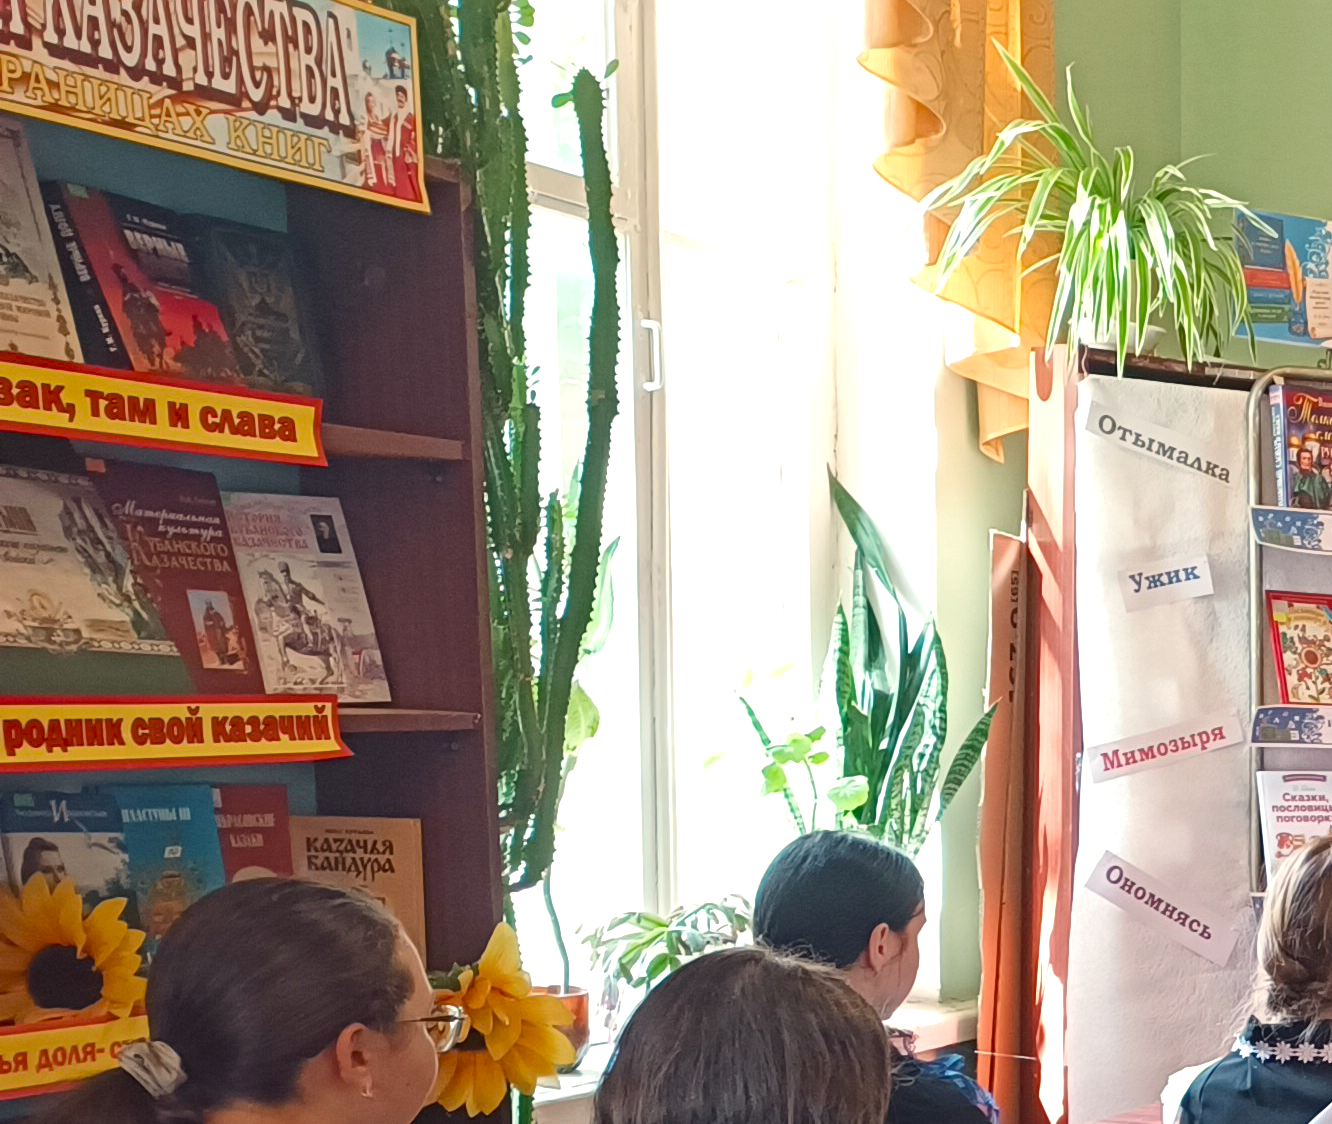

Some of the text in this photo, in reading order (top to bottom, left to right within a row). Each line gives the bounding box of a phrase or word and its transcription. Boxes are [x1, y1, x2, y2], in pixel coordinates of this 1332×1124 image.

[226, 114, 332, 172] КНИГ
[84, 389, 157, 425] там
[167, 401, 190, 430] и
[200, 405, 297, 443] слава
[1098, 414, 1231, 484] Отымалка
[1129, 565, 1200, 593] Ужик
[3, 704, 331, 756] родник свой казачий
[1100, 726, 1226, 772] Мимозыря
[1282, 791, 1329, 803] Сказки,
[306, 837, 394, 856] КАЗАЧЬЯ
[307, 854, 395, 882] БАНДУРА
[1105, 865, 1212, 941] Ономнясь
